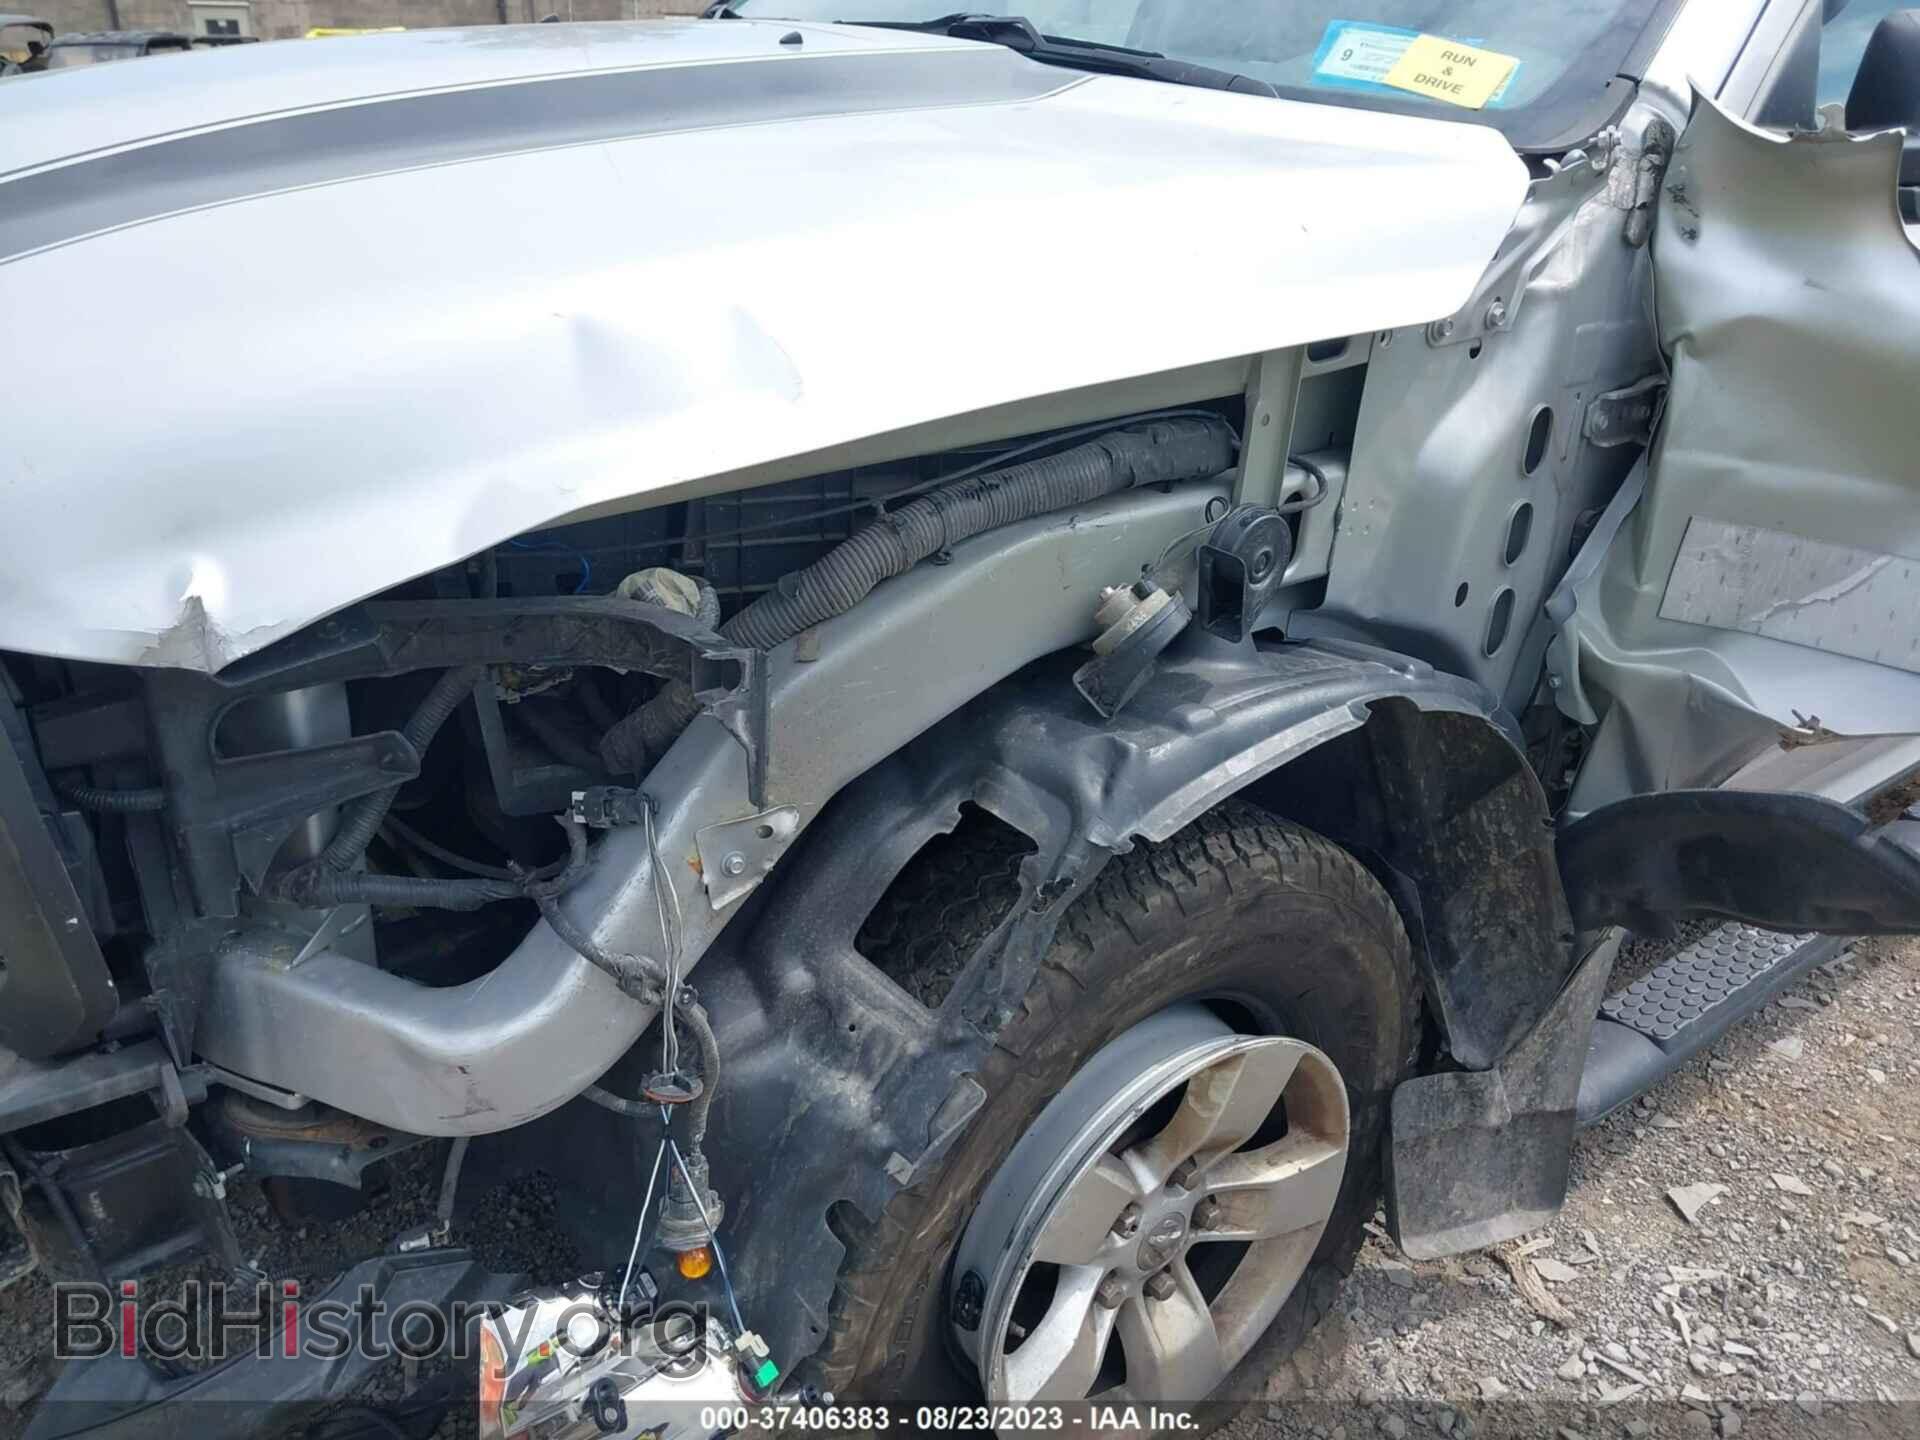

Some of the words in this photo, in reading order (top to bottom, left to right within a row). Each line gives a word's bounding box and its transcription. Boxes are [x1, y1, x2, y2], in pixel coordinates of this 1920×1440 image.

[1441, 50, 1478, 67] RUN
[1442, 66, 1453, 77] &
[1413, 73, 1464, 95] DRIVE
